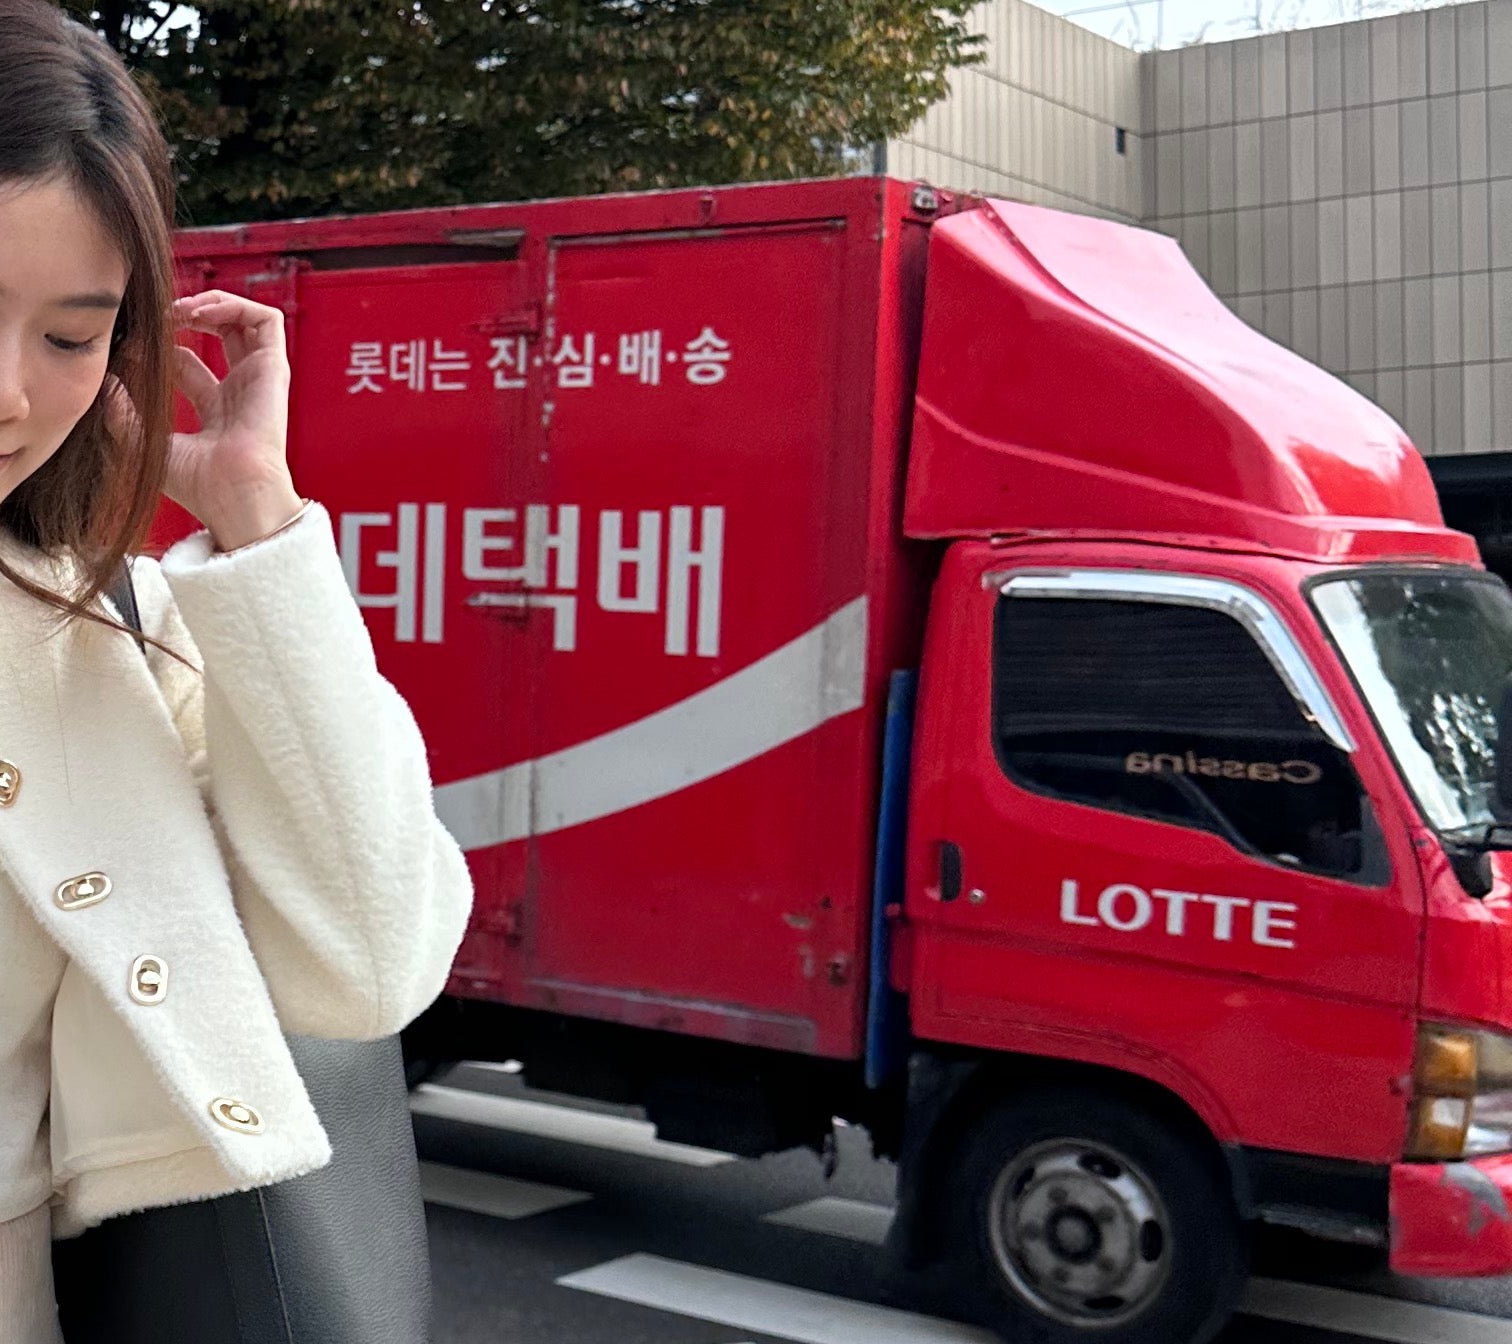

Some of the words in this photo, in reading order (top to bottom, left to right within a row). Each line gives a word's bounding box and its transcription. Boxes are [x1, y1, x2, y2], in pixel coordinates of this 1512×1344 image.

[345, 340, 471, 394] 롯데는
[486, 326, 733, 390] 진·심·배·송
[339, 501, 726, 658] 데택배
[1060, 878, 1298, 949] LOTTE
